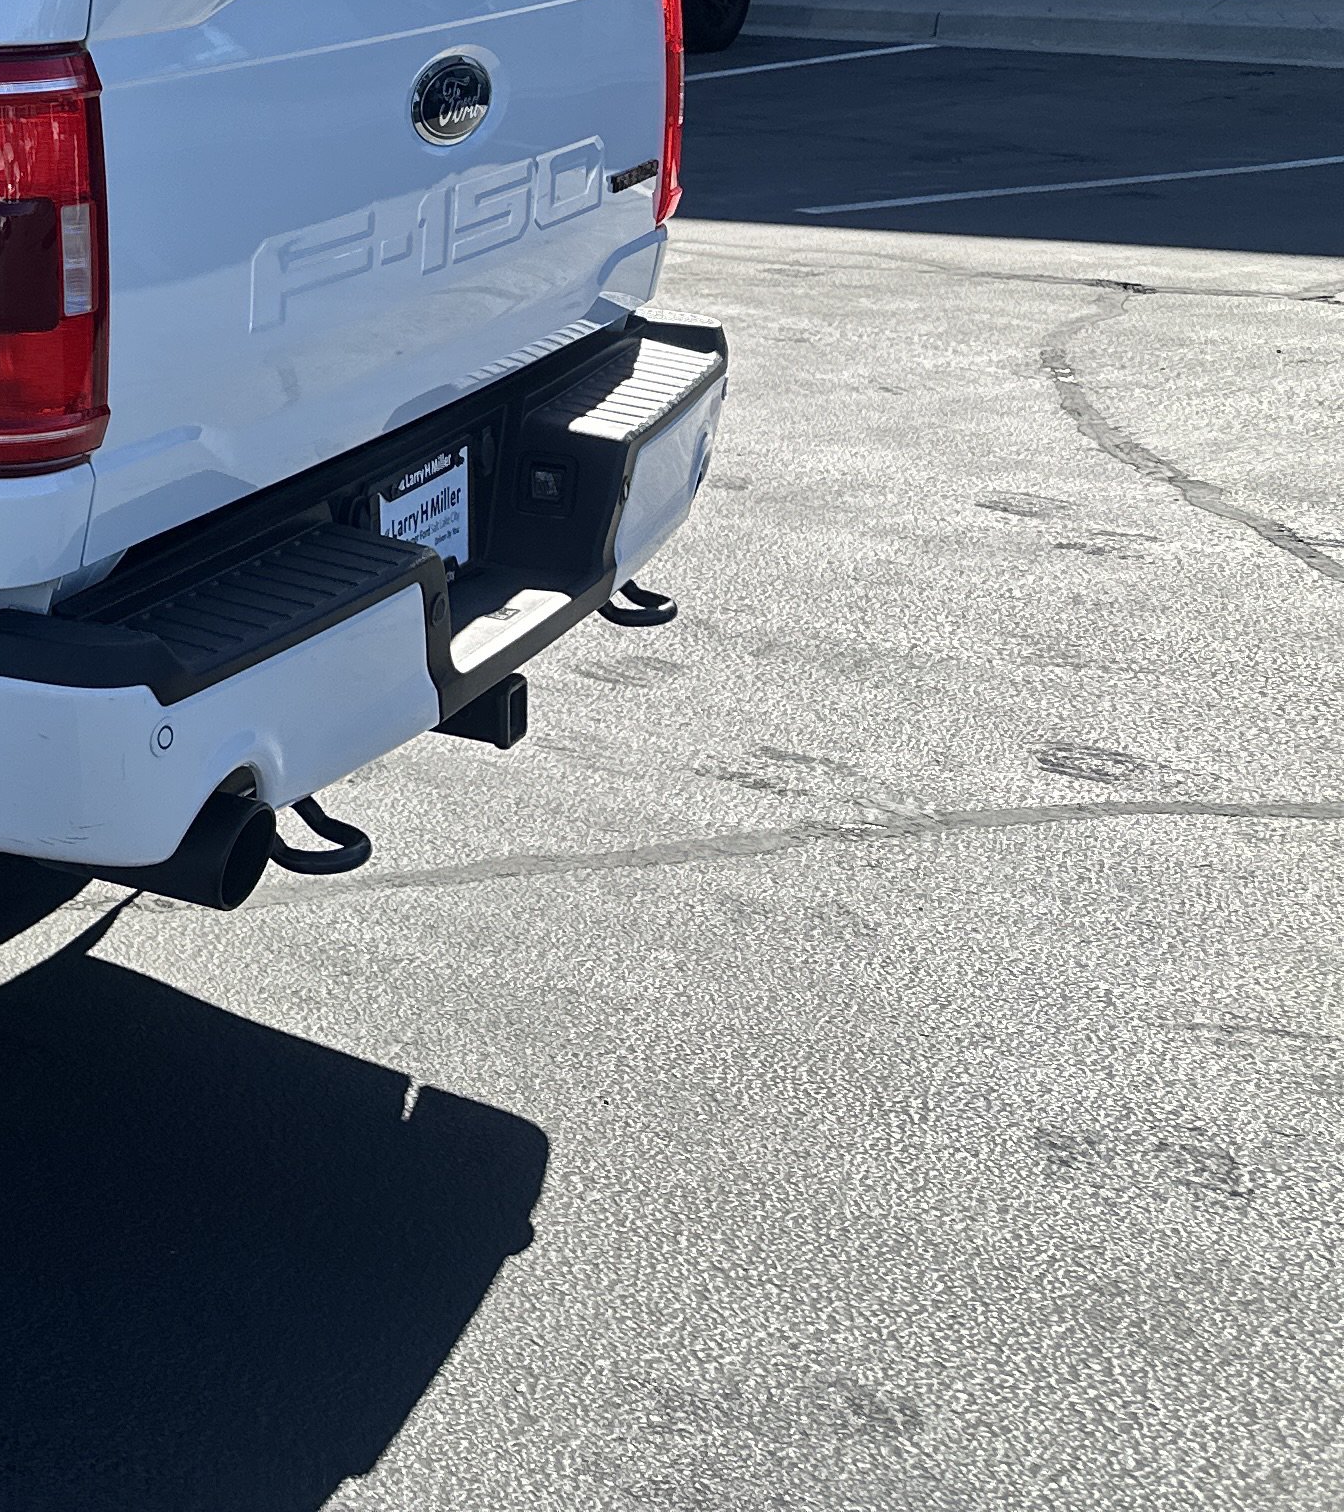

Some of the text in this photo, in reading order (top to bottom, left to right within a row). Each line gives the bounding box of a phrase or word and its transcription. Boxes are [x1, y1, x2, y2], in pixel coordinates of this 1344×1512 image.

[439, 76, 482, 127] Ford
[248, 134, 606, 335] F-150
[404, 452, 452, 489] Larry H Miller
[391, 486, 462, 540] Larry H Miller
